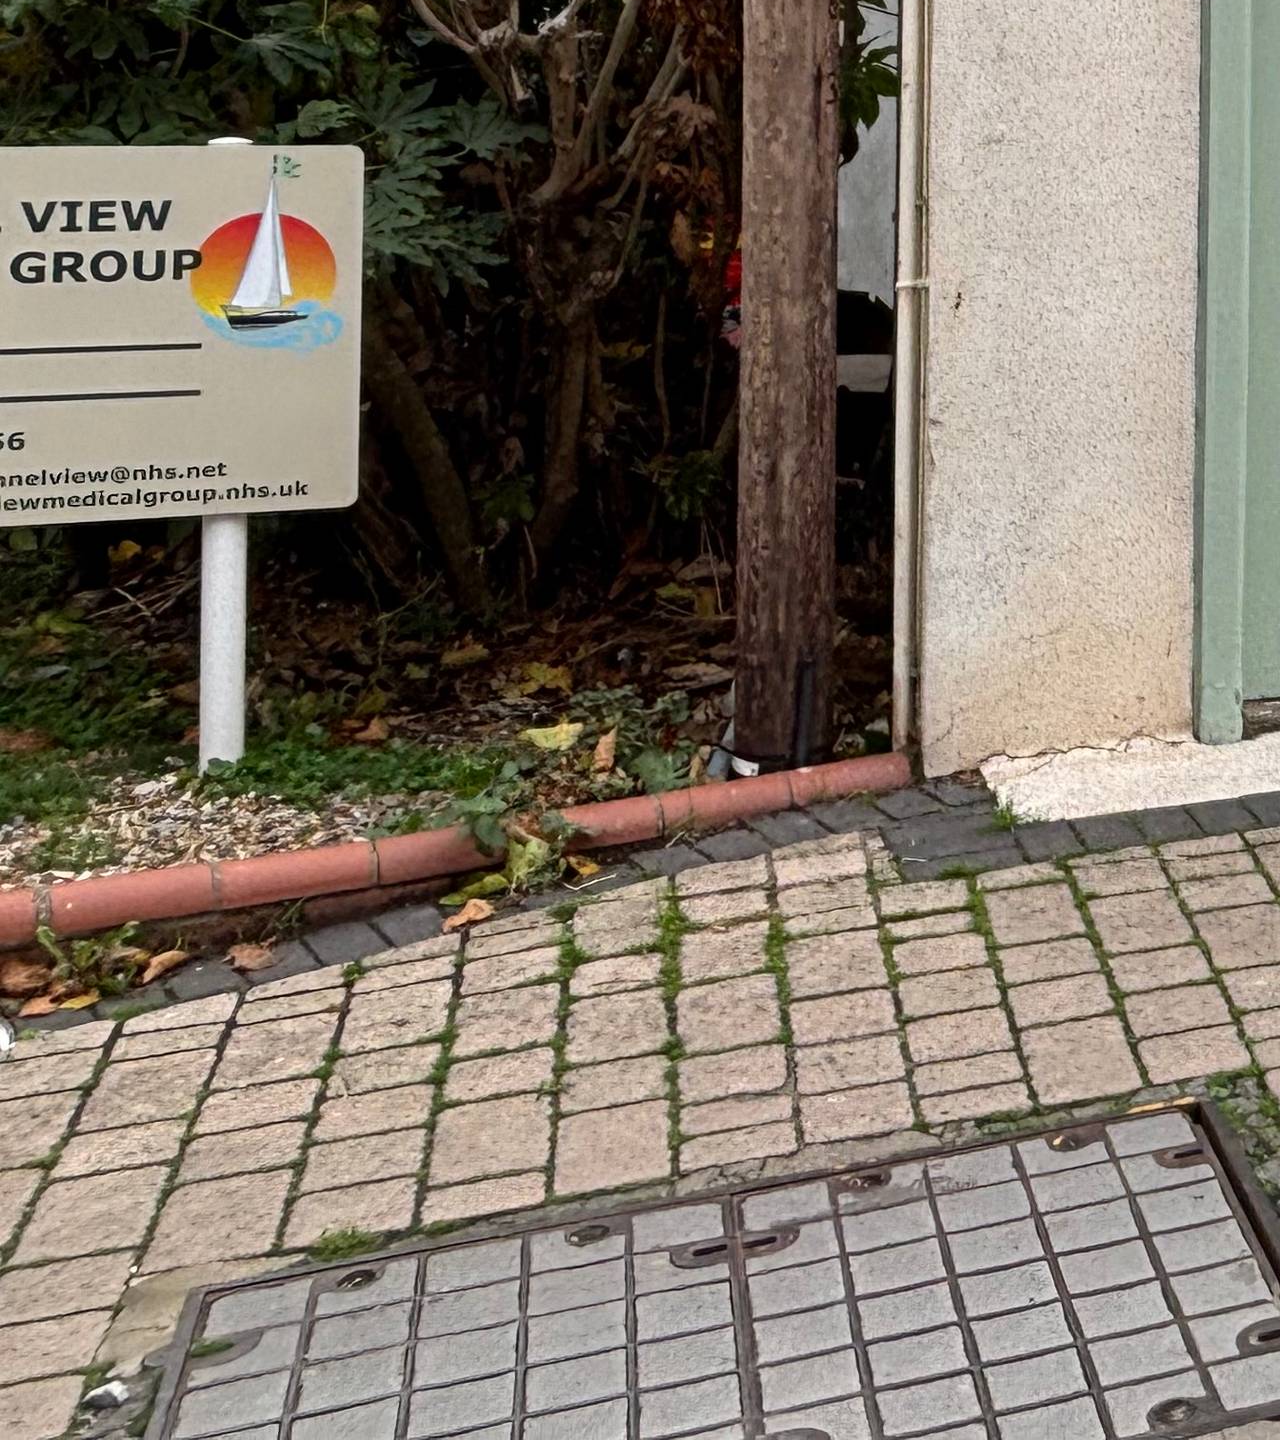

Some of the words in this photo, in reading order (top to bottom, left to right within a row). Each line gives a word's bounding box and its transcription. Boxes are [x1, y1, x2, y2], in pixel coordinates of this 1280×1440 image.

[21, 199, 173, 233] VIEW
[10, 249, 203, 284] GROUP
[0, 480, 309, 511] ewmedicalgroup.nhs.uk
